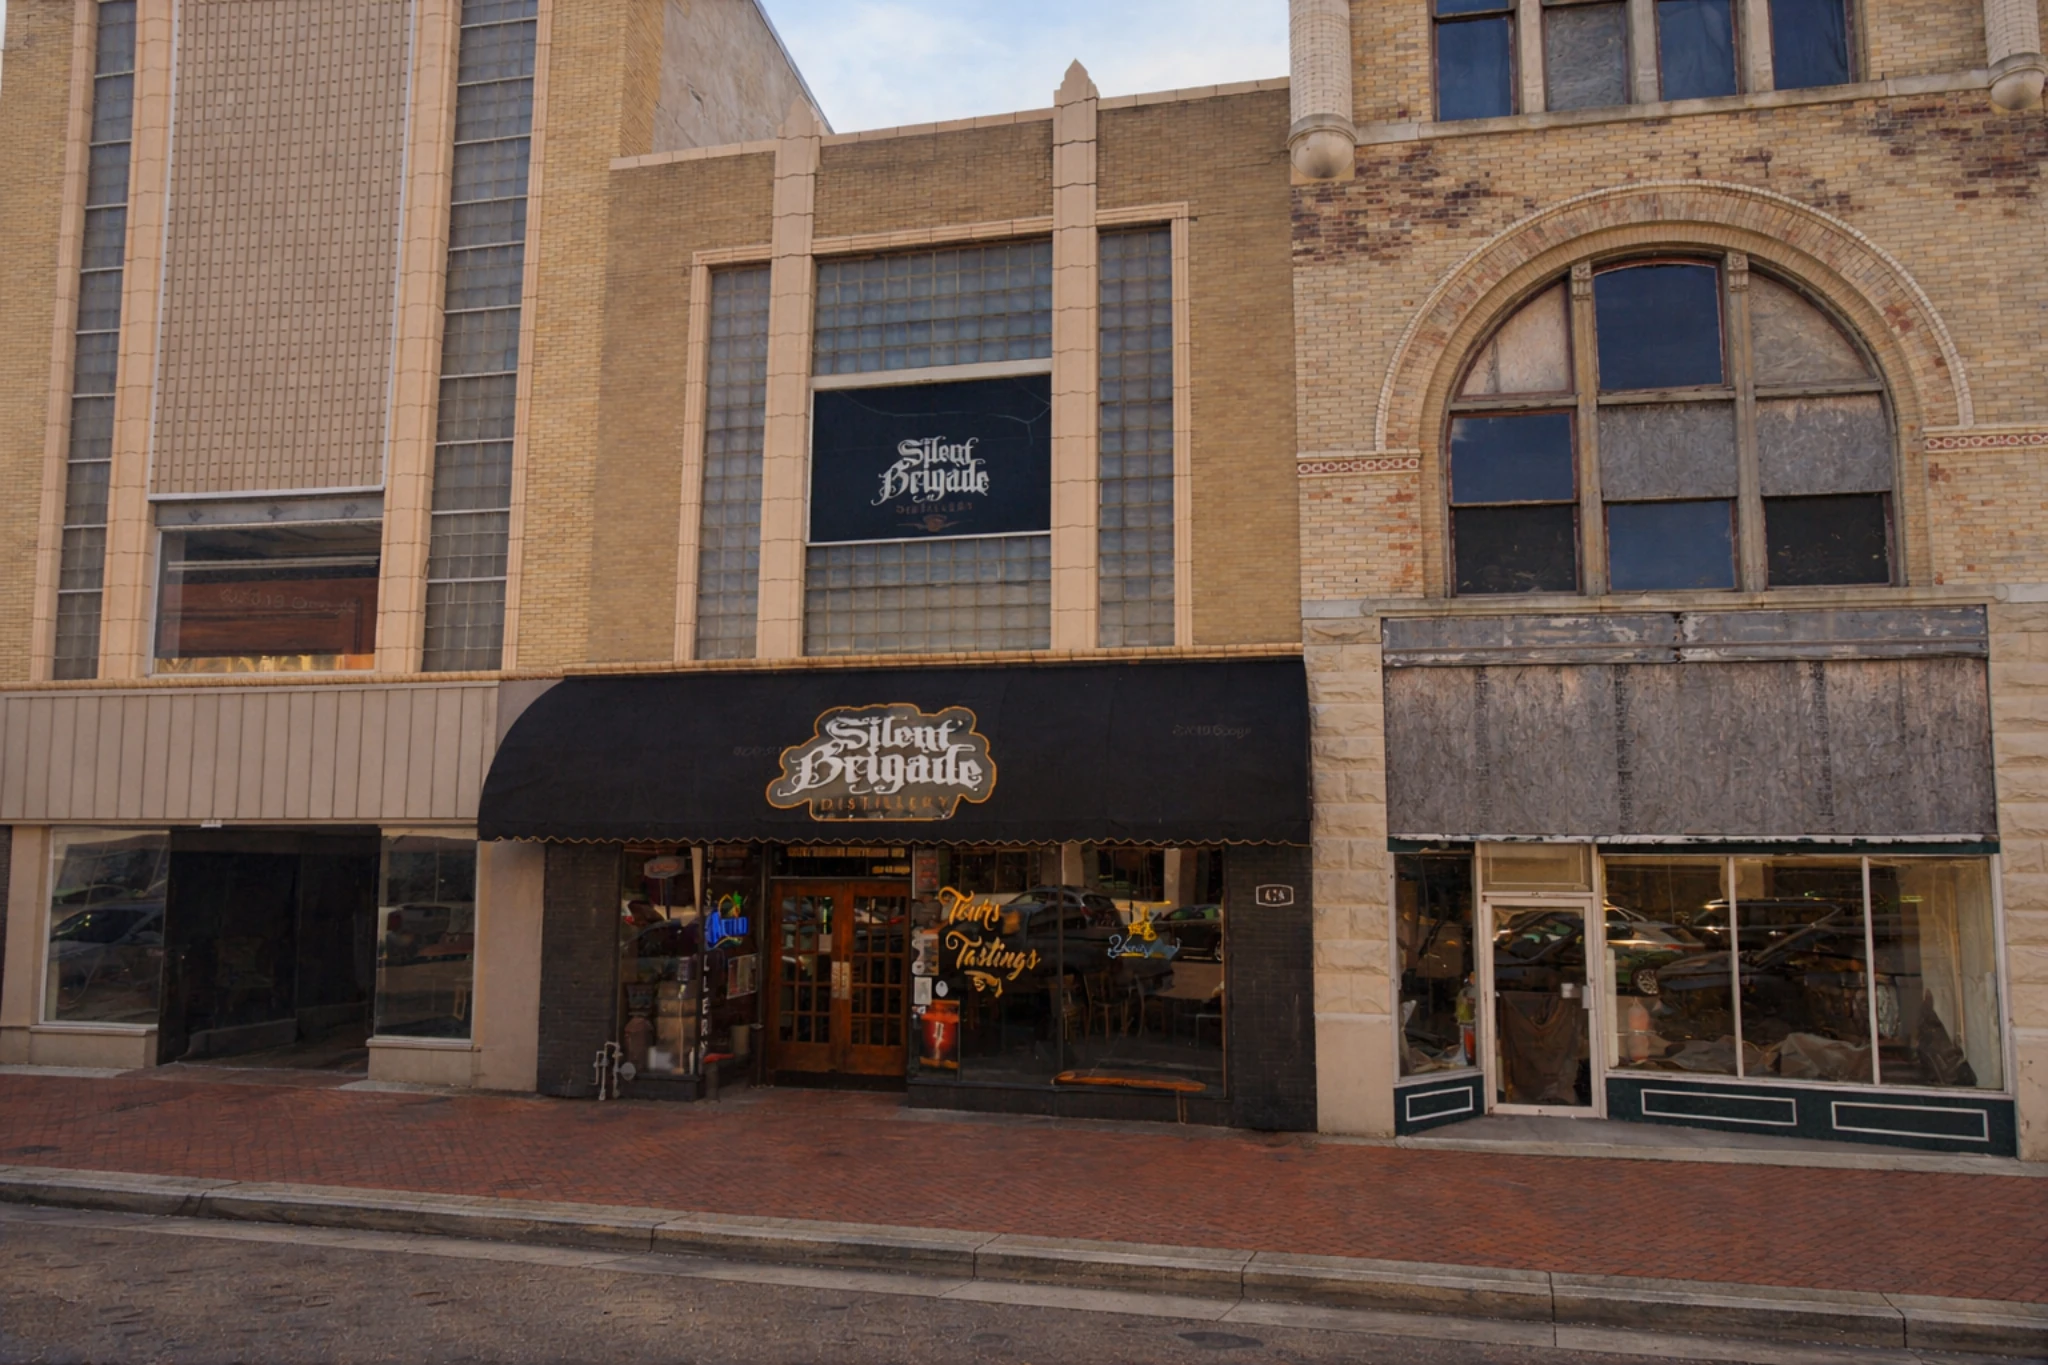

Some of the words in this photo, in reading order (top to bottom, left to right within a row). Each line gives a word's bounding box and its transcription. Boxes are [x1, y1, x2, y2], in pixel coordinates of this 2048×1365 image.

[897, 436, 979, 465] Silent
[871, 457, 990, 506] Brigade
[825, 715, 962, 753] Silent
[777, 743, 983, 797] Brigade
[820, 796, 950, 812] DISTILLERY
[938, 885, 1001, 931] Tours
[945, 930, 1041, 981] Tastings
